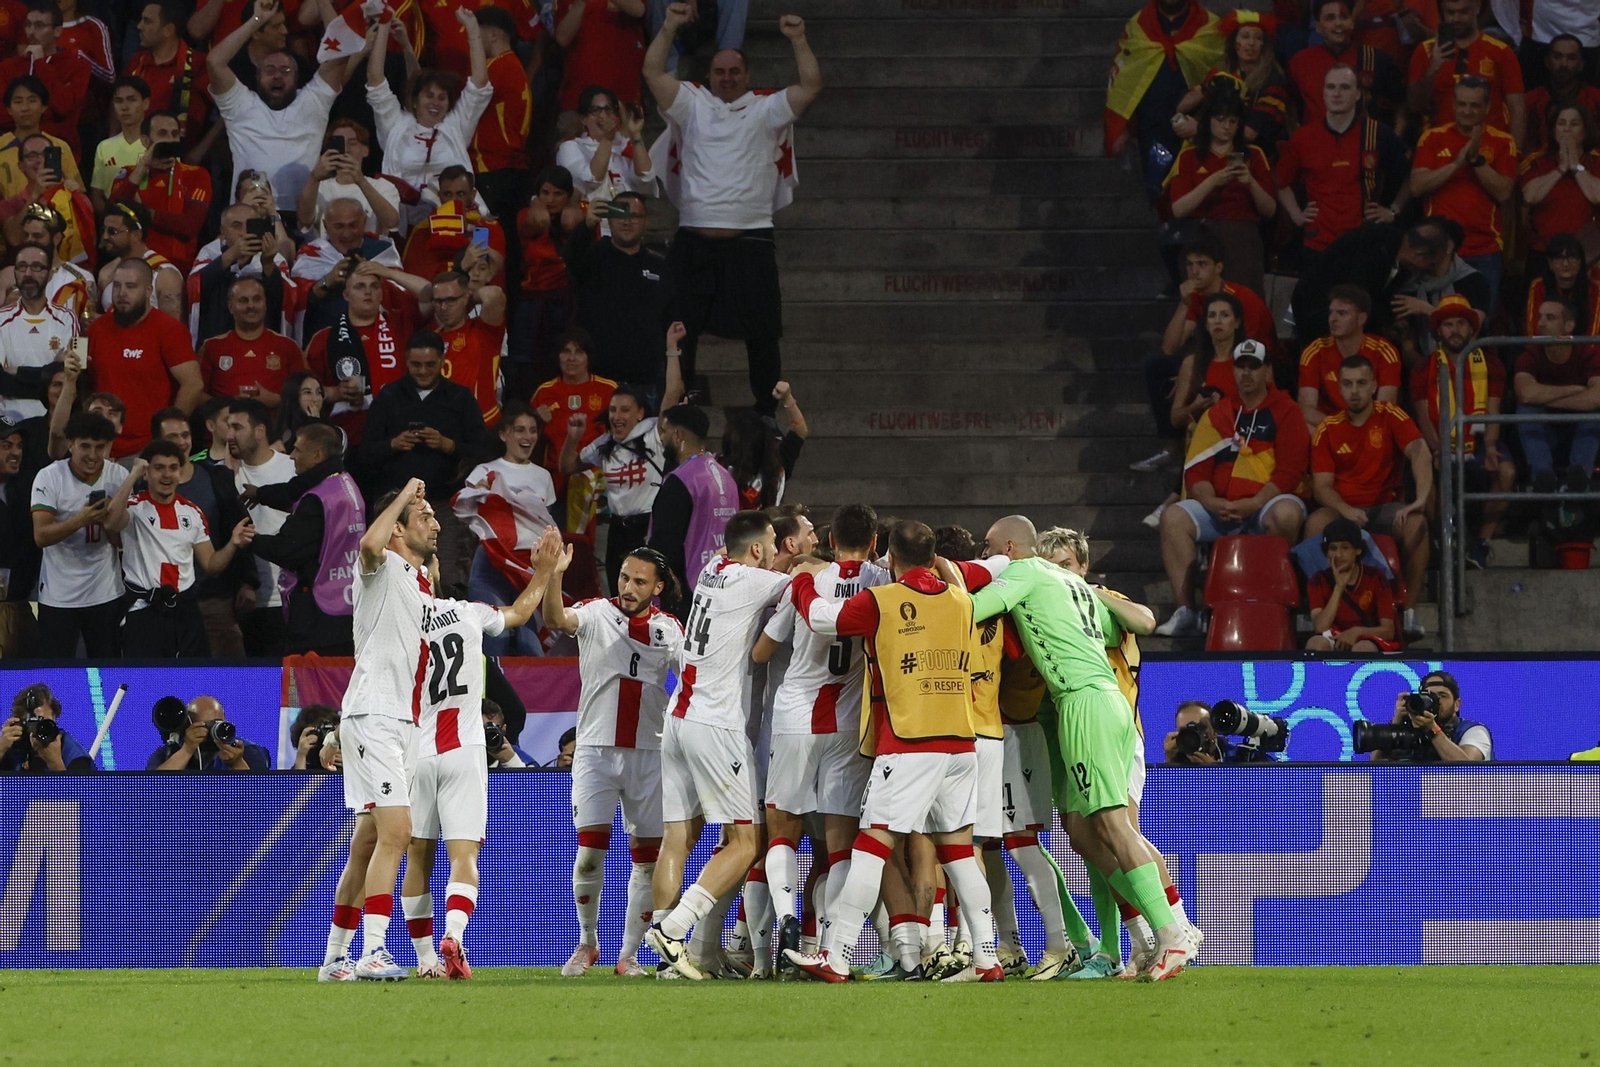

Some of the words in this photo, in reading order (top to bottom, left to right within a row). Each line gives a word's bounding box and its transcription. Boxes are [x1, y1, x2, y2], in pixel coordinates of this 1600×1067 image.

[122, 347, 144, 360] RWE
[868, 410, 961, 430] FLUCHTWEG
[1063, 578, 1103, 640] 12
[684, 593, 713, 656] 14
[897, 625, 926, 634] EURO2024
[428, 633, 469, 706] 22
[629, 652, 641, 678] 6
[1070, 762, 1091, 792] 12
[1002, 783, 1016, 811] 1
